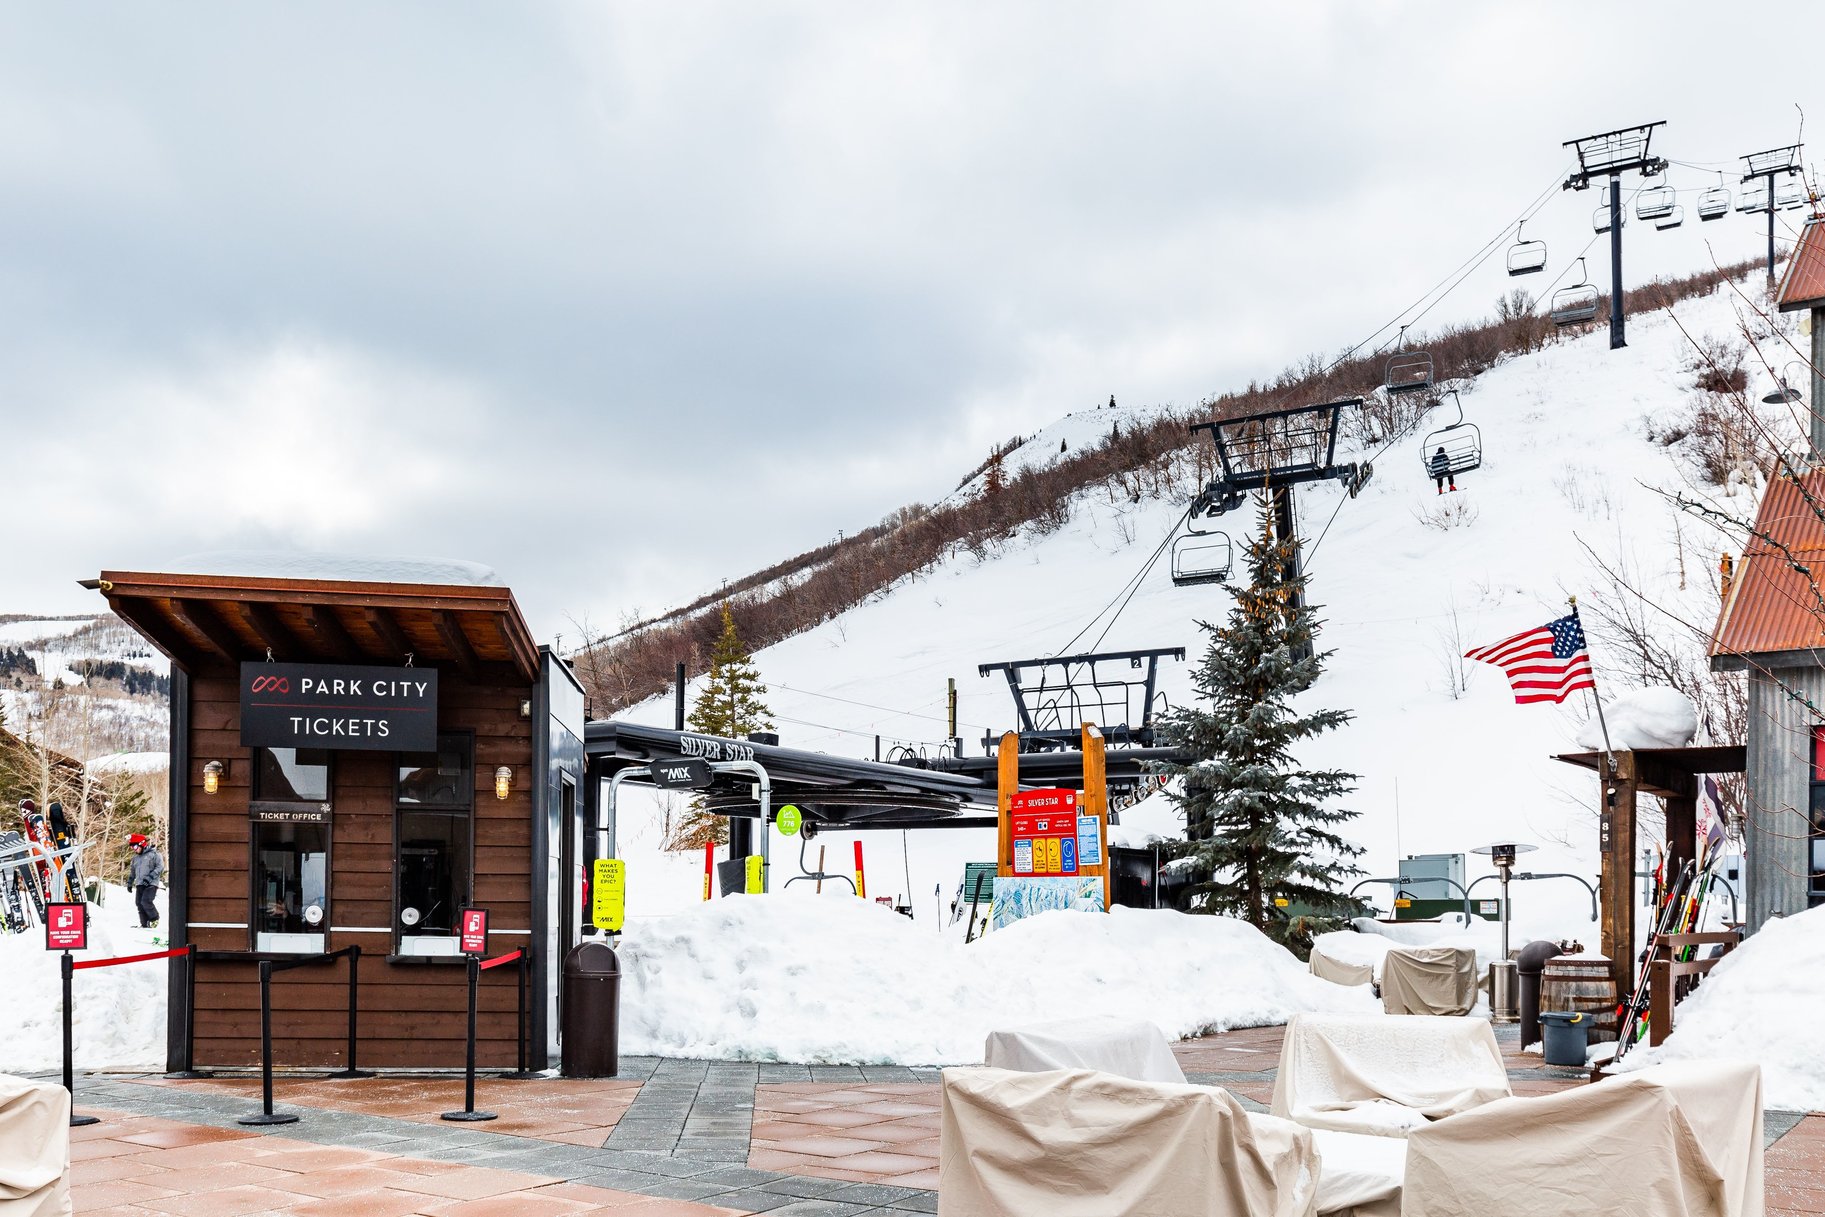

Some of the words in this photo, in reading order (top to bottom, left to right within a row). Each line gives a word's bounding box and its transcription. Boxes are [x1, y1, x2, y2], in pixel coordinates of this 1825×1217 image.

[1133, 659, 1139, 668] 2
[301, 678, 362, 696] PARK
[373, 681, 427, 697] CITY
[290, 717, 389, 737] TICKETS
[681, 736, 721, 759] SILVER
[725, 743, 754, 761] STAR
[668, 767, 691, 780] MIX
[1028, 798, 1045, 807] SILVER
[1045, 797, 1059, 806] STAR
[259, 812, 290, 820] TICKET
[292, 813, 322, 821] OFFICE
